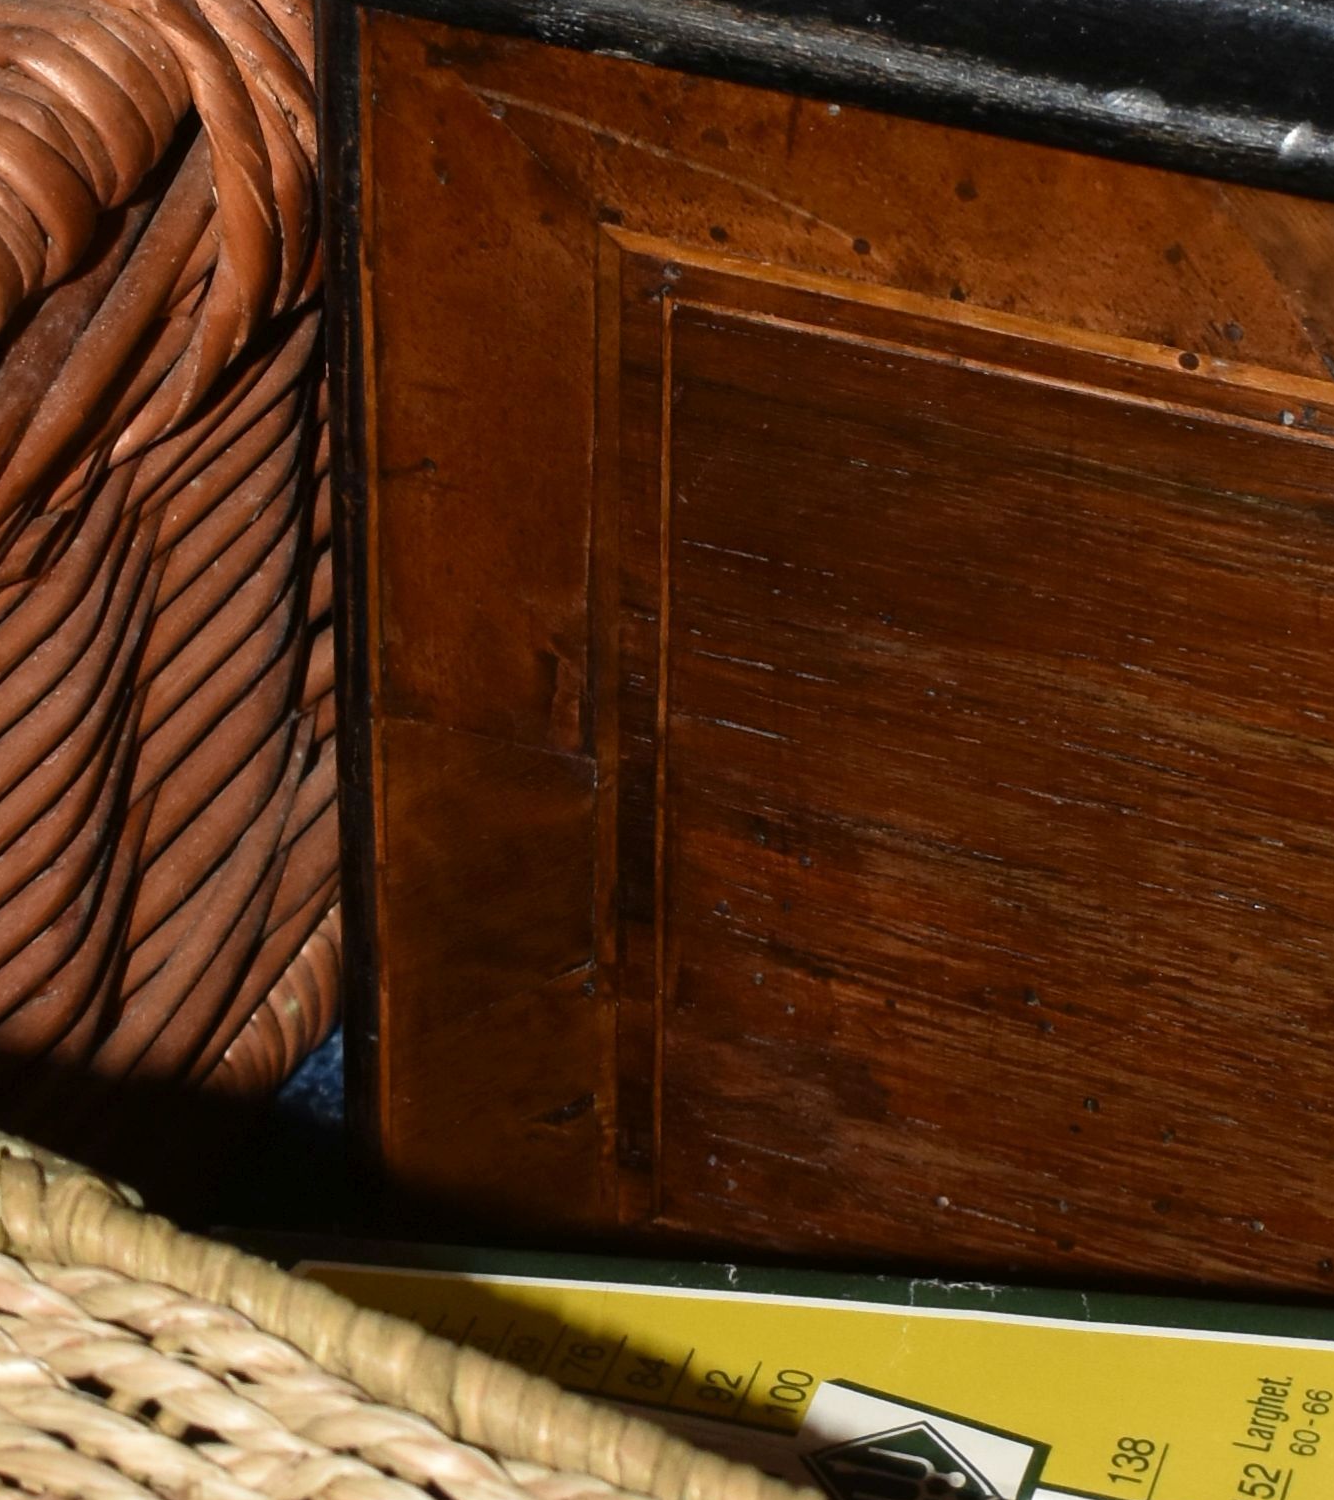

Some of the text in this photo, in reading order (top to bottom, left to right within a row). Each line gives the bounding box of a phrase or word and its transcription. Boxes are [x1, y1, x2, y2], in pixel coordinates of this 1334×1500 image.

[625, 1356, 671, 1391] 84
[696, 1368, 743, 1403] 92
[763, 1368, 814, 1415] 100
[1232, 1375, 1294, 1453] Larghet.
[1107, 1436, 1156, 1485] 138
